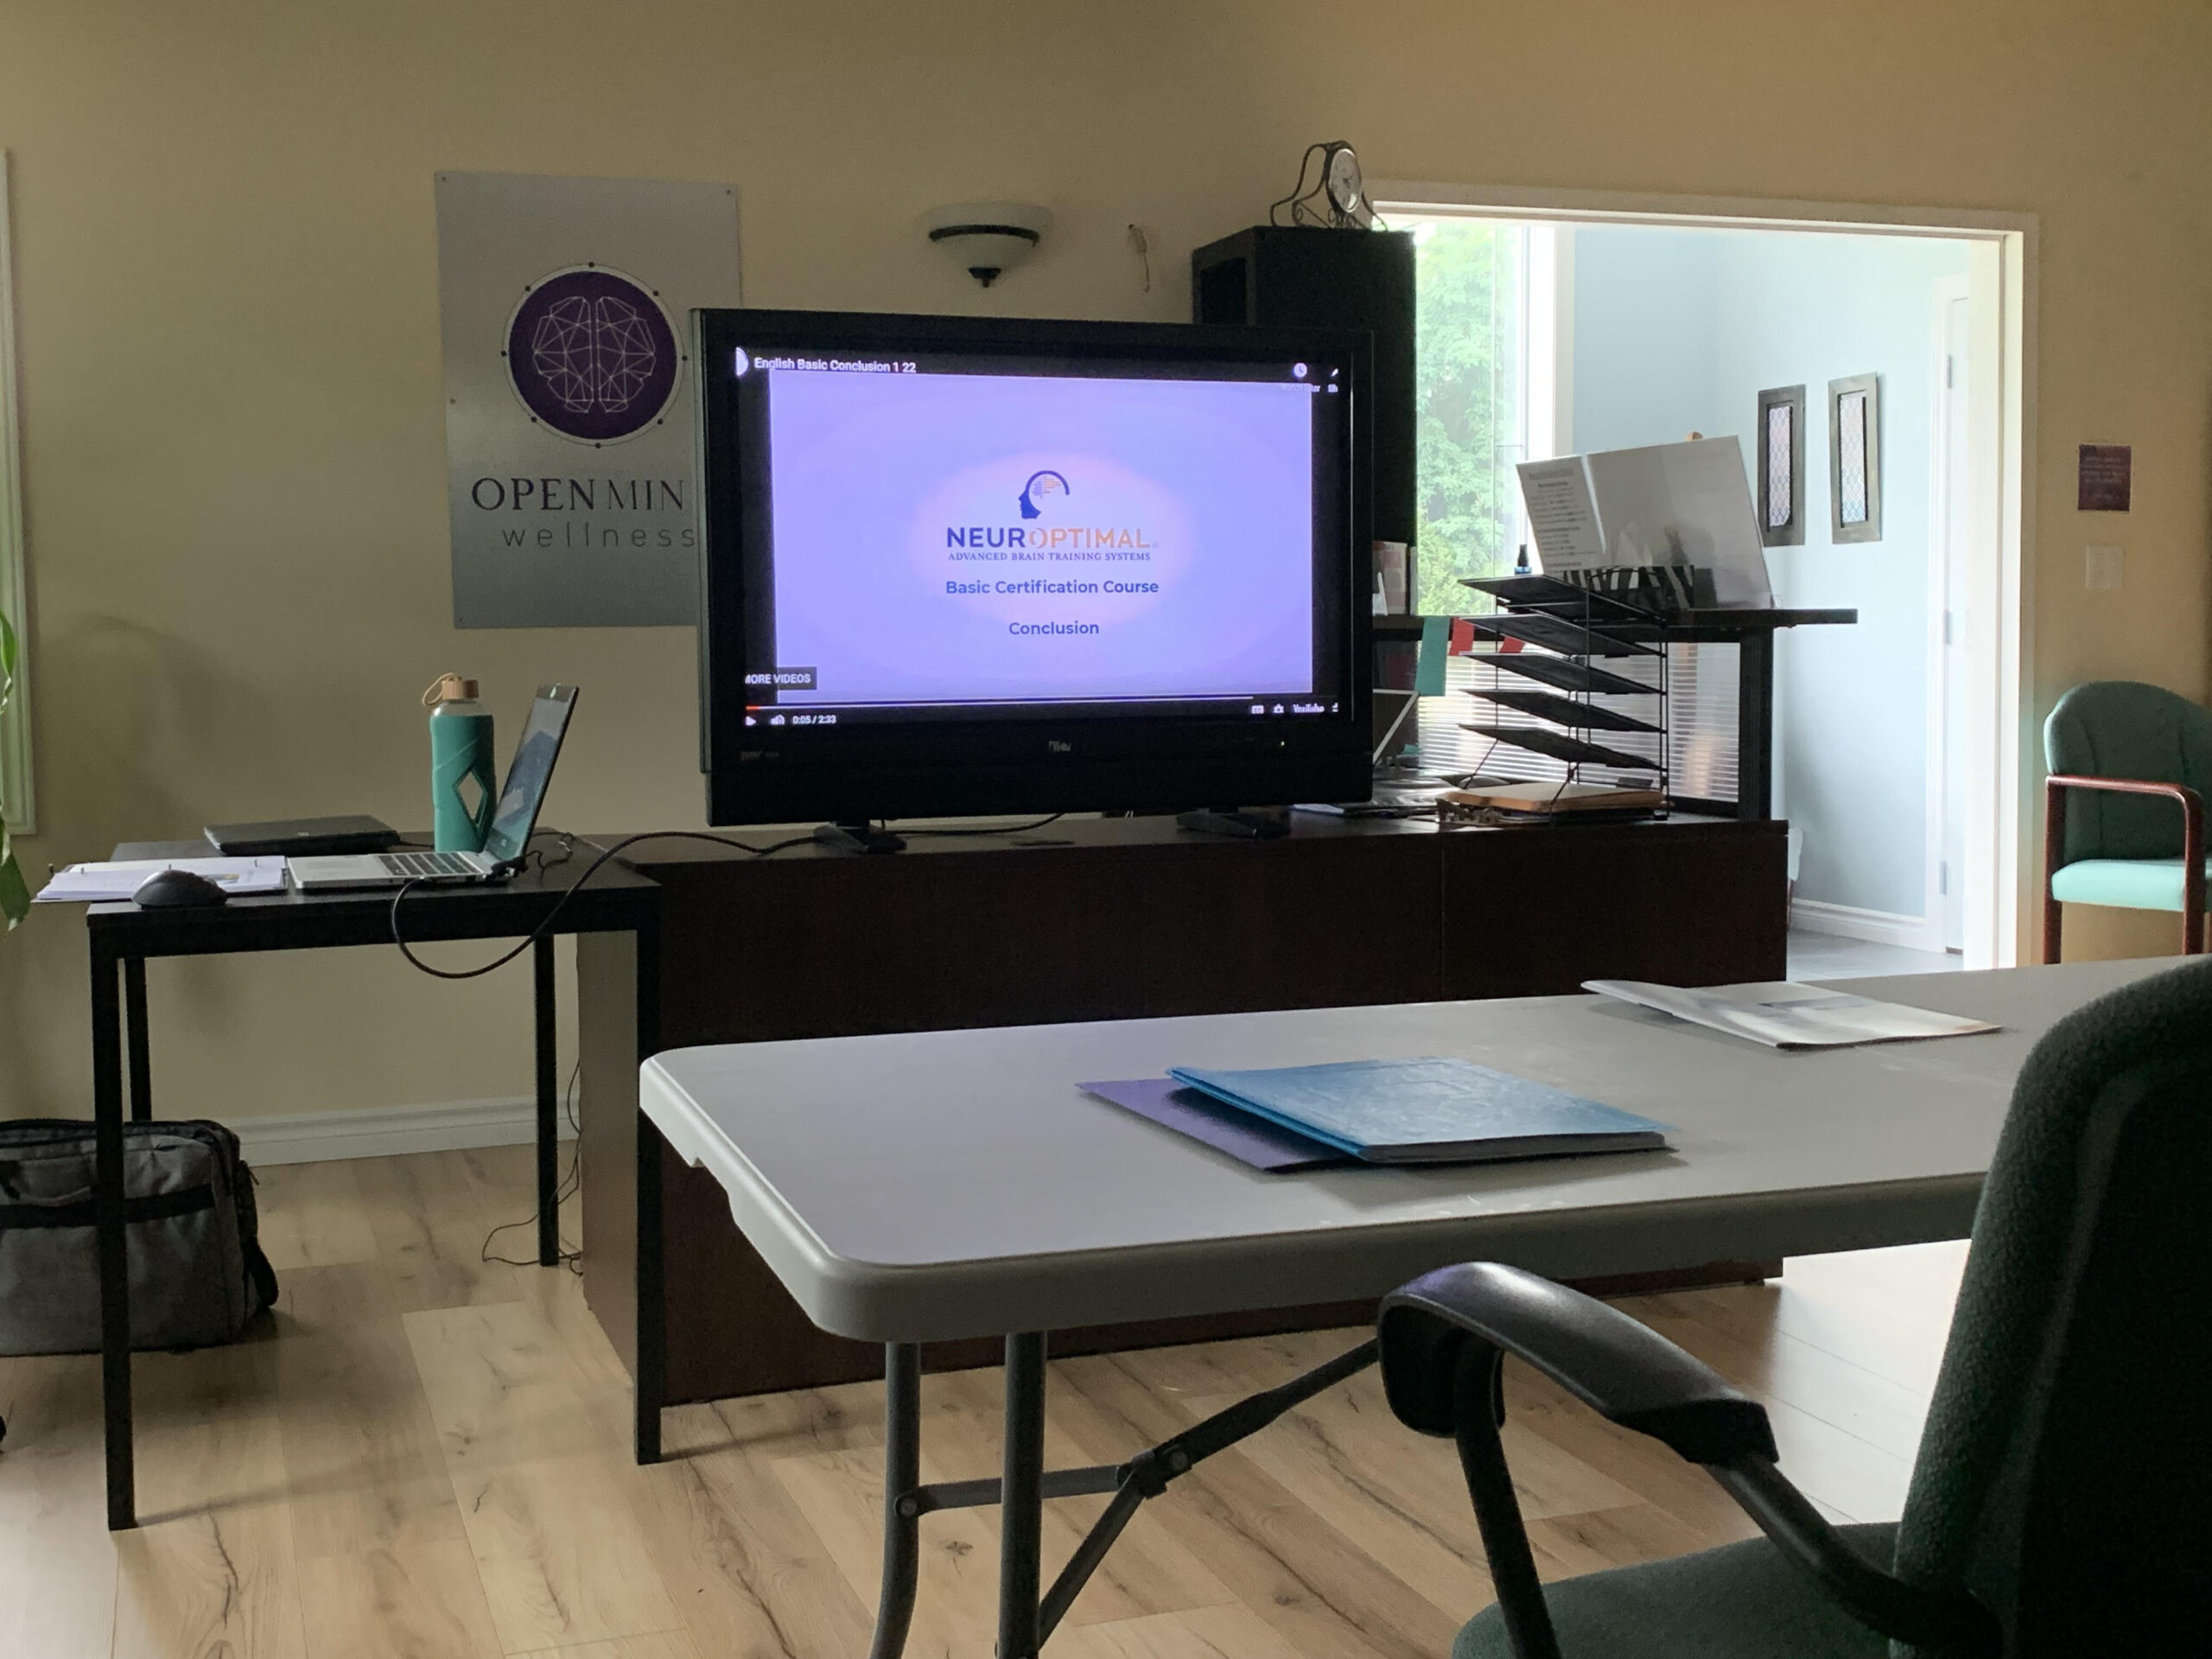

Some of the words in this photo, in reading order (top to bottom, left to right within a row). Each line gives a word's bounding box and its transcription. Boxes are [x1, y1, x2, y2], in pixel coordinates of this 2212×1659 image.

[754, 357, 795, 370] English
[797, 359, 828, 370] Basic
[830, 359, 891, 372] Conclusion
[902, 362, 917, 372] 22
[502, 521, 696, 548] wellness
[948, 552, 1007, 561] ADVANCED
[1012, 552, 1045, 561] BRAIN
[1048, 552, 1102, 561] TRAINING
[1105, 552, 1151, 561] SYSTEMS
[946, 580, 991, 594] Basic
[995, 580, 1099, 594] Certification
[1103, 580, 1160, 594] Course
[1009, 620, 1099, 635] Conclusion
[773, 673, 811, 684] VIDEOS
